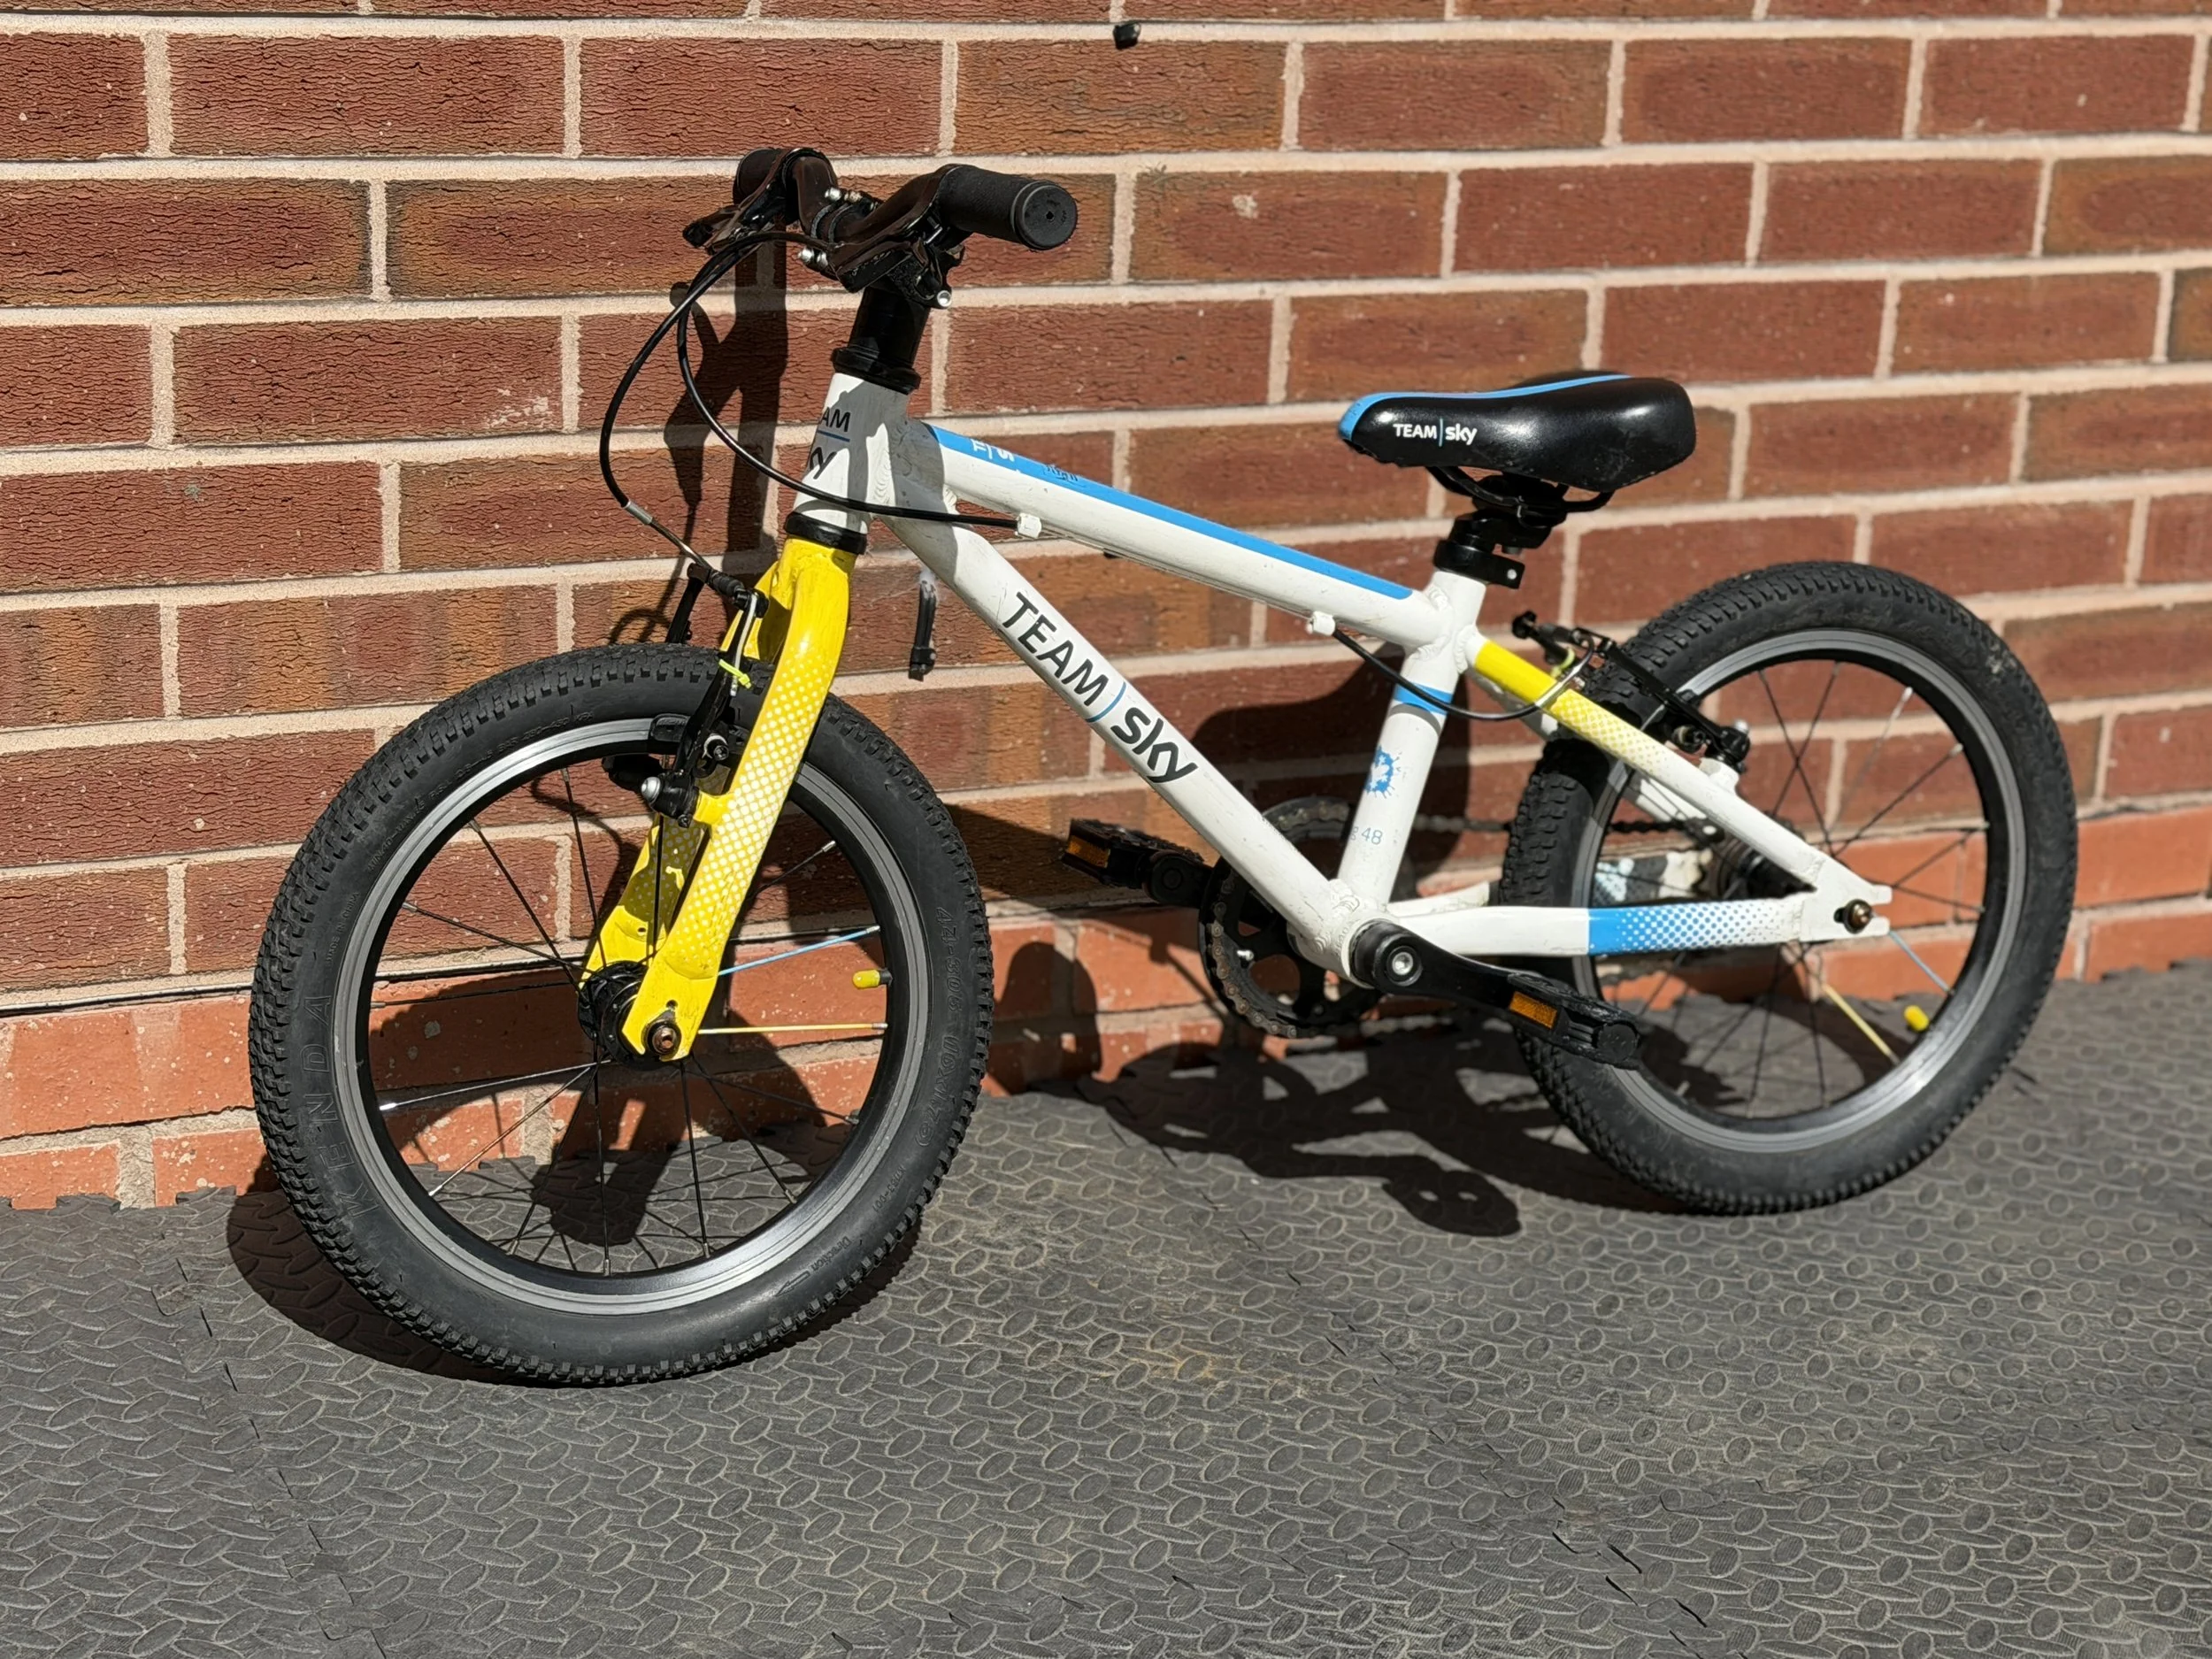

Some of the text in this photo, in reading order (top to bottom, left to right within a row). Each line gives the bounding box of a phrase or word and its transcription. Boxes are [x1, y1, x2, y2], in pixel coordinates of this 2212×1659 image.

[819, 406, 851, 433] AM
[1393, 423, 1438, 440] TEAM
[1002, 591, 1110, 707] TEAM
[1361, 826, 1384, 846] 48
[300, 995, 380, 1218] KENDA
[810, 1235, 852, 1272] Direction
